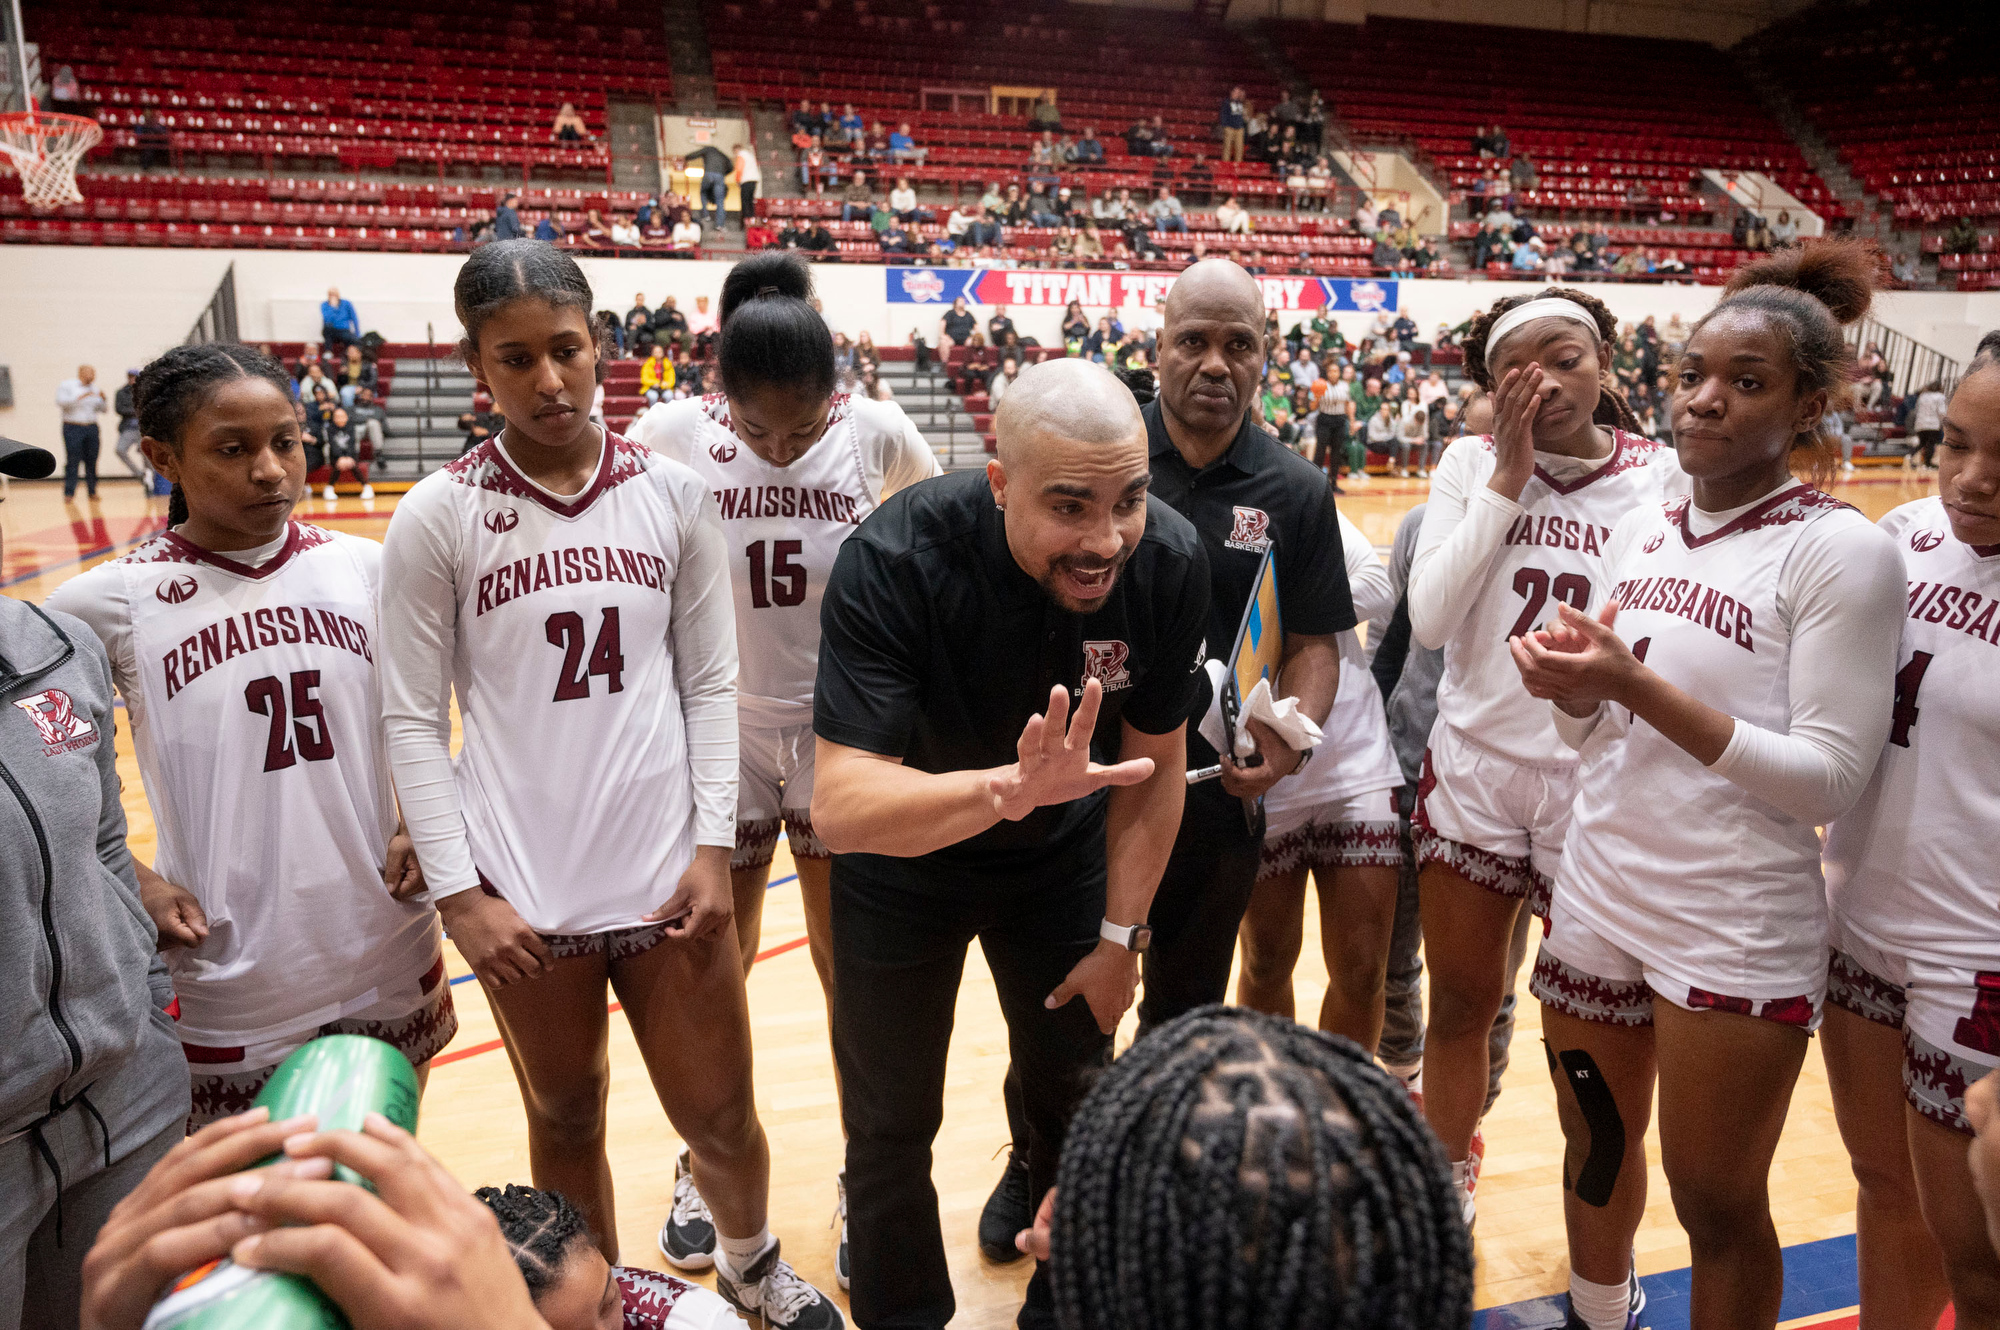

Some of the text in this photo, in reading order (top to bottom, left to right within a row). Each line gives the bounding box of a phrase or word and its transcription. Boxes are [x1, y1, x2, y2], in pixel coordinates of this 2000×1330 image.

[1006, 273, 1112, 305] TITAN
[713, 485, 861, 526] NAISSANCE
[1224, 540, 1265, 554] BASKETBA
[476, 546, 667, 618] RENAISSANCE
[746, 540, 807, 609] 15
[163, 606, 375, 702] RENAISSANCE
[544, 606, 625, 703] 24
[1074, 680, 1133, 697] BAETBALL
[244, 669, 335, 773] 25
[42, 745, 66, 757] LADY
[1575, 1069, 1589, 1078] KT
